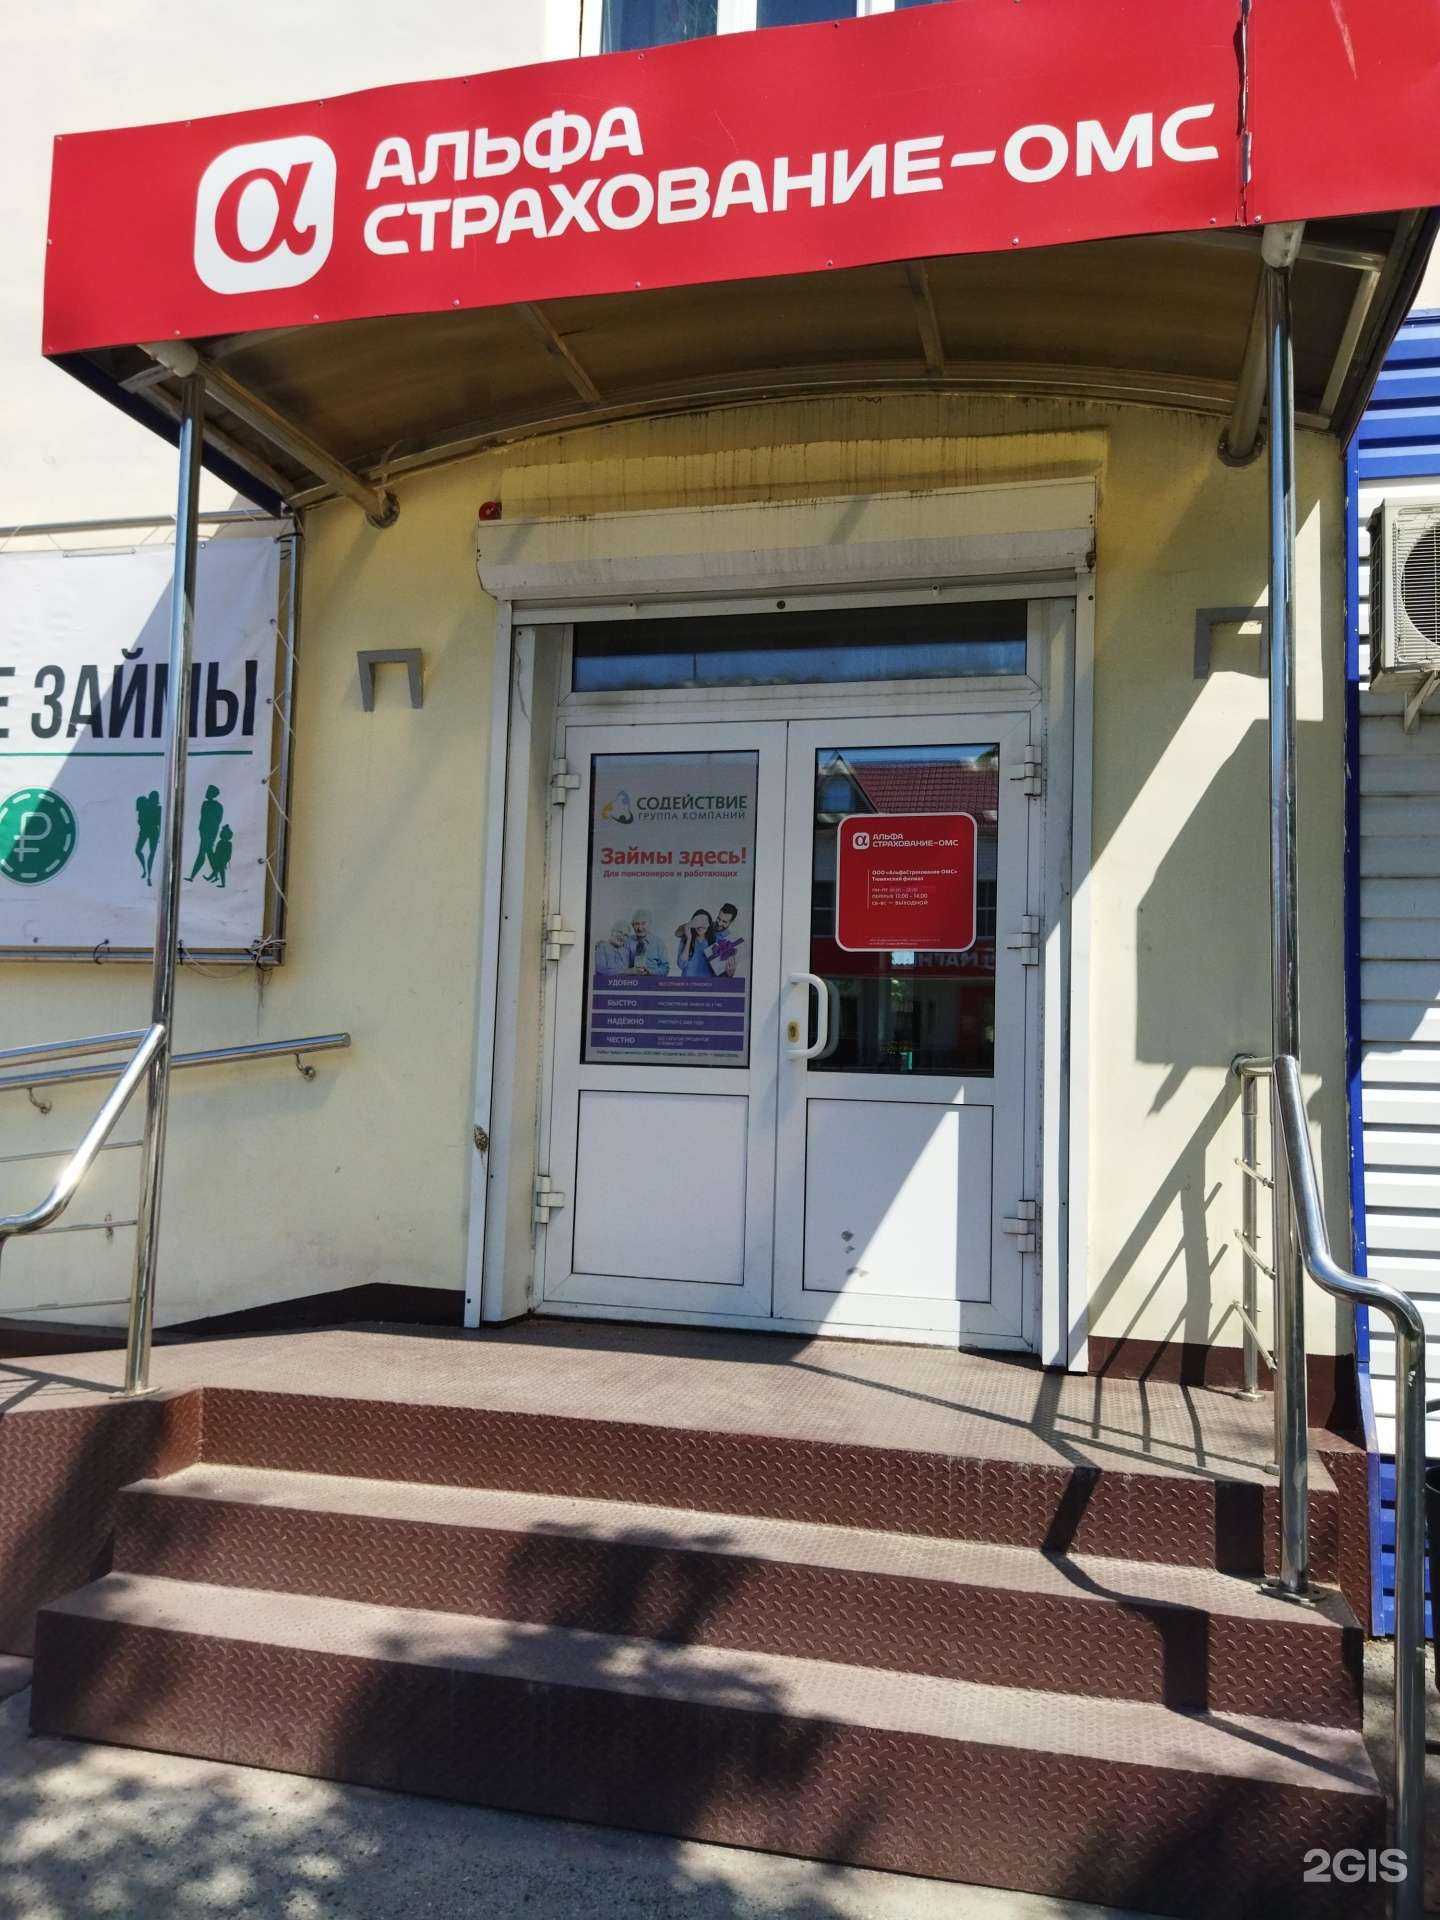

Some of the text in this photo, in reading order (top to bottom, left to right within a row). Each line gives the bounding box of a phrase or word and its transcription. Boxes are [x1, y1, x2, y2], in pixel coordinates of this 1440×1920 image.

[366, 106, 644, 190] АЛЬФА
[363, 103, 1220, 256] СТРАХОВАНИЕ-ОМС
[31, 647, 258, 739] ЗАЙМЫ
[636, 794, 748, 811] СОДЕЙСТВИЕ
[638, 811, 679, 821] ГРУППА
[872, 839, 959, 848] СТРАХОВАНИЕ-ОМС
[600, 846, 748, 867] Займы здесь!
[603, 869, 620, 878] Для
[621, 870, 675, 878] пенсионеров
[684, 869, 738, 878] работающих
[607, 979, 639, 987] УДОБНО
[606, 1036, 636, 1044] ЧЕСТНО
